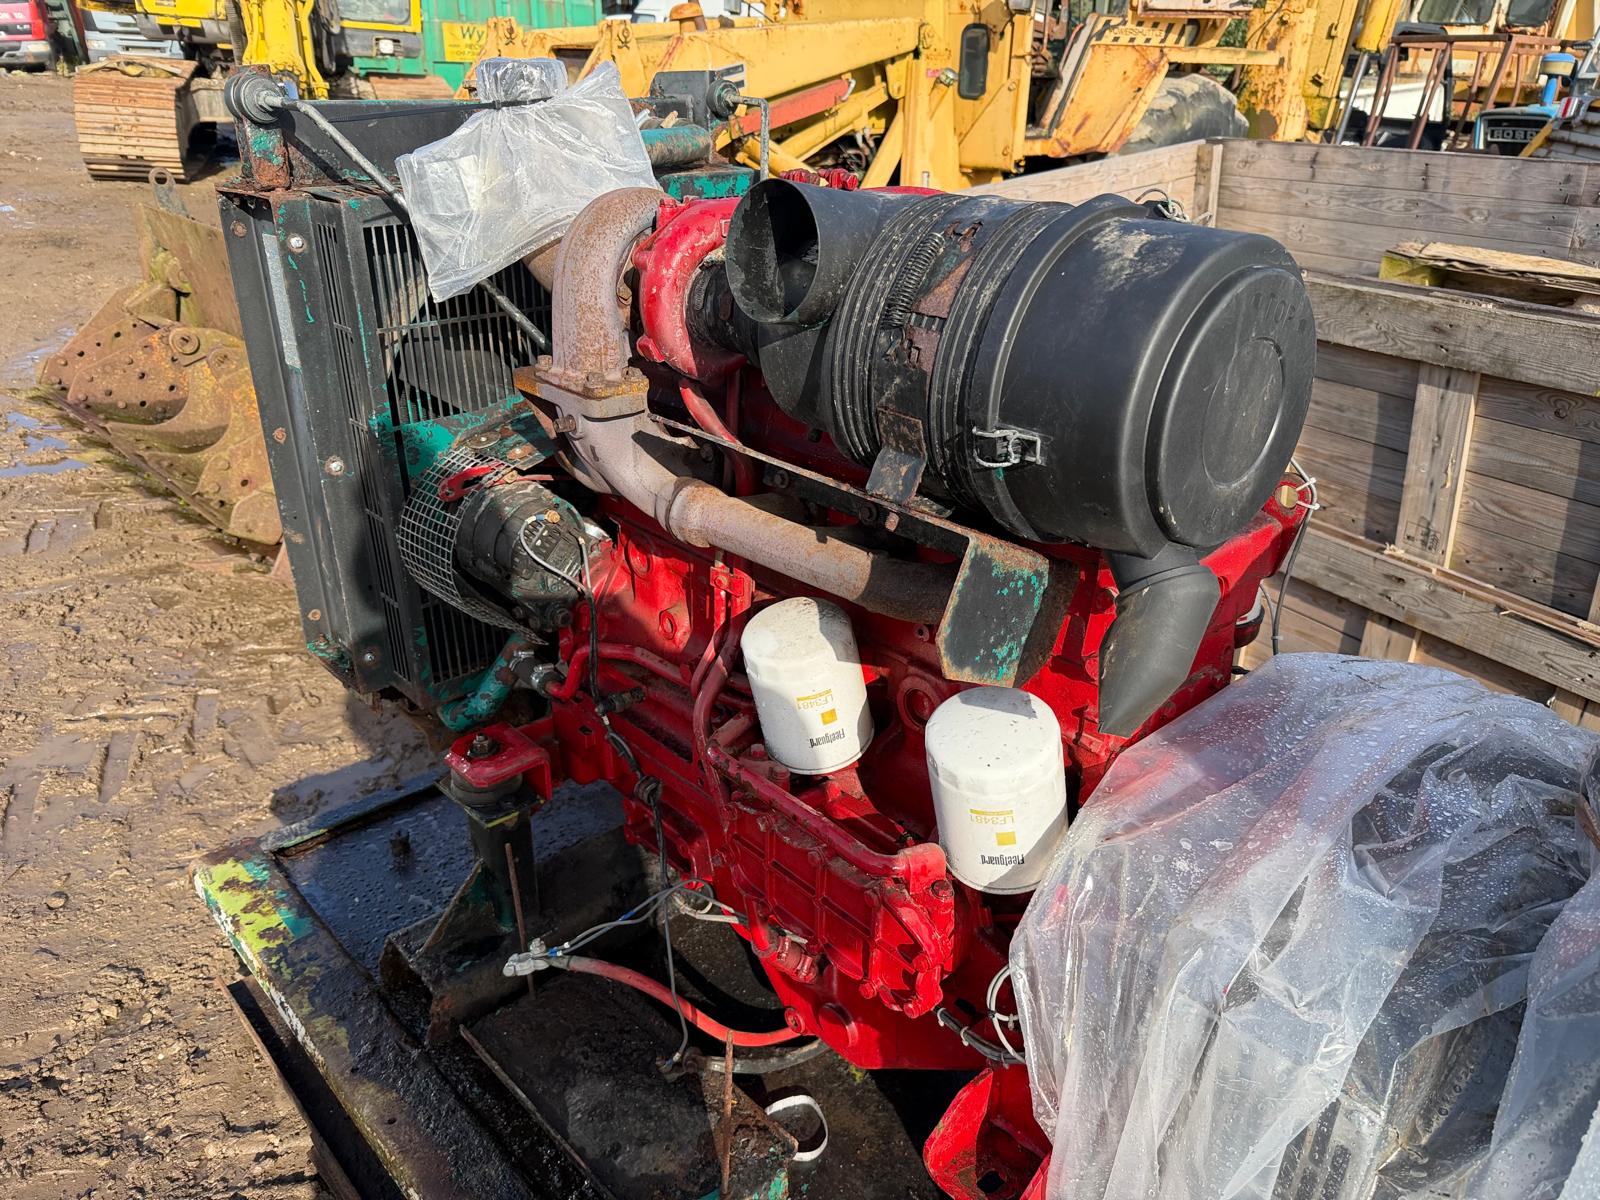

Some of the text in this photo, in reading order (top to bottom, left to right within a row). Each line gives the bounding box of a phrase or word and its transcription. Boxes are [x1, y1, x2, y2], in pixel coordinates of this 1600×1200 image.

[1493, 129, 1537, 140] FORD
[809, 728, 846, 749] Fleetguard
[980, 854, 1025, 867] Fleetguard
